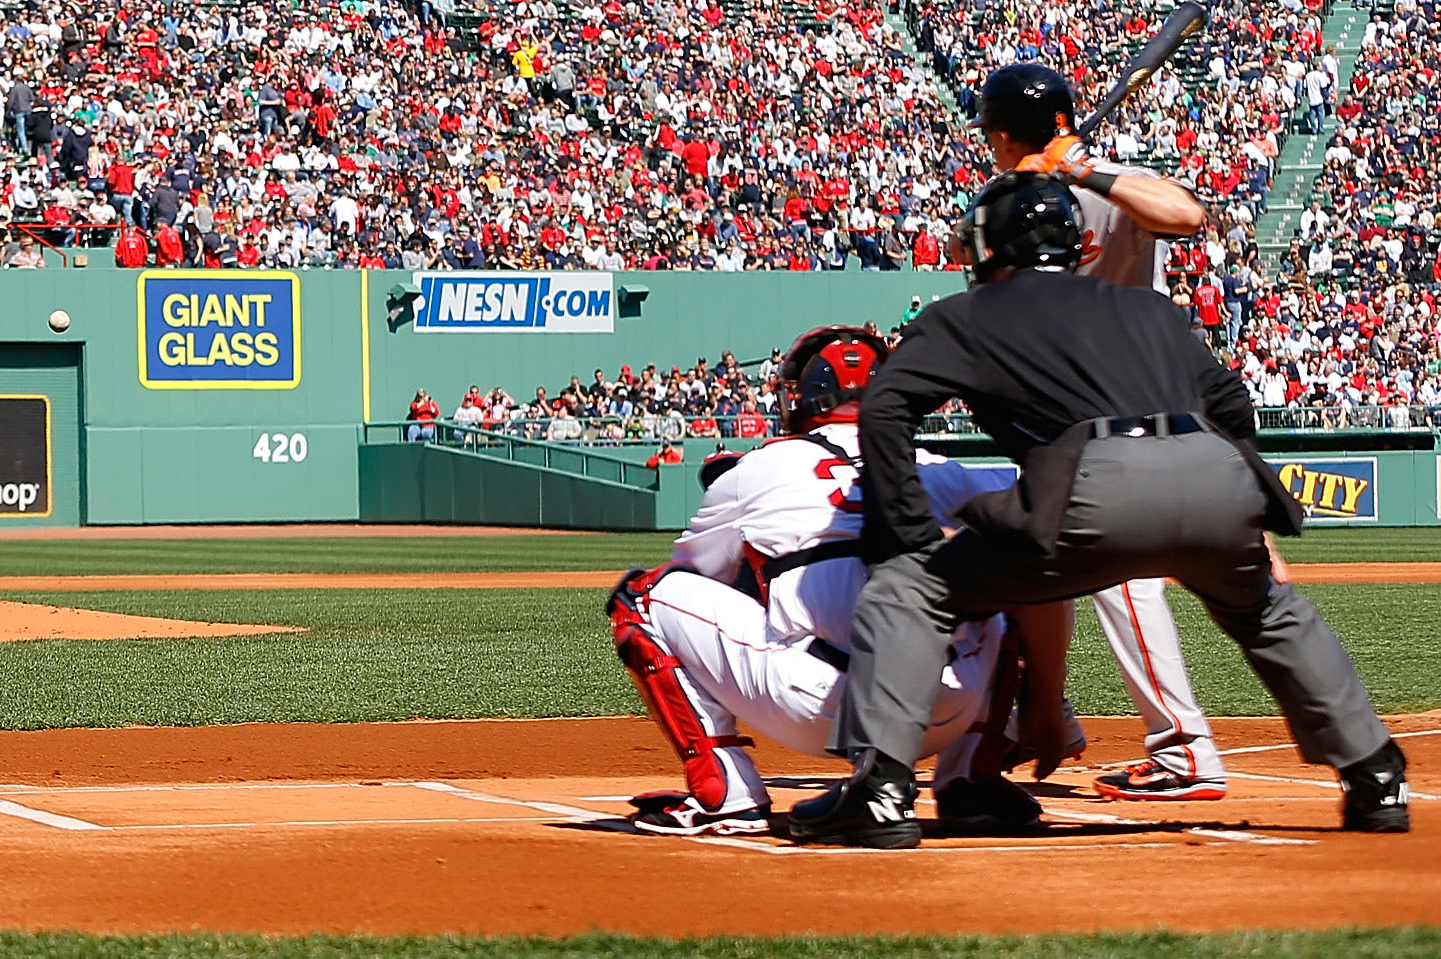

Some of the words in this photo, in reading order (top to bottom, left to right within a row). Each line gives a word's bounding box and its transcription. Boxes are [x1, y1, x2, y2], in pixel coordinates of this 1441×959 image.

[162, 293, 272, 328] GIANT
[158, 332, 279, 367] GLASS
[252, 432, 308, 464] 420
[1278, 463, 1368, 513] CITY
